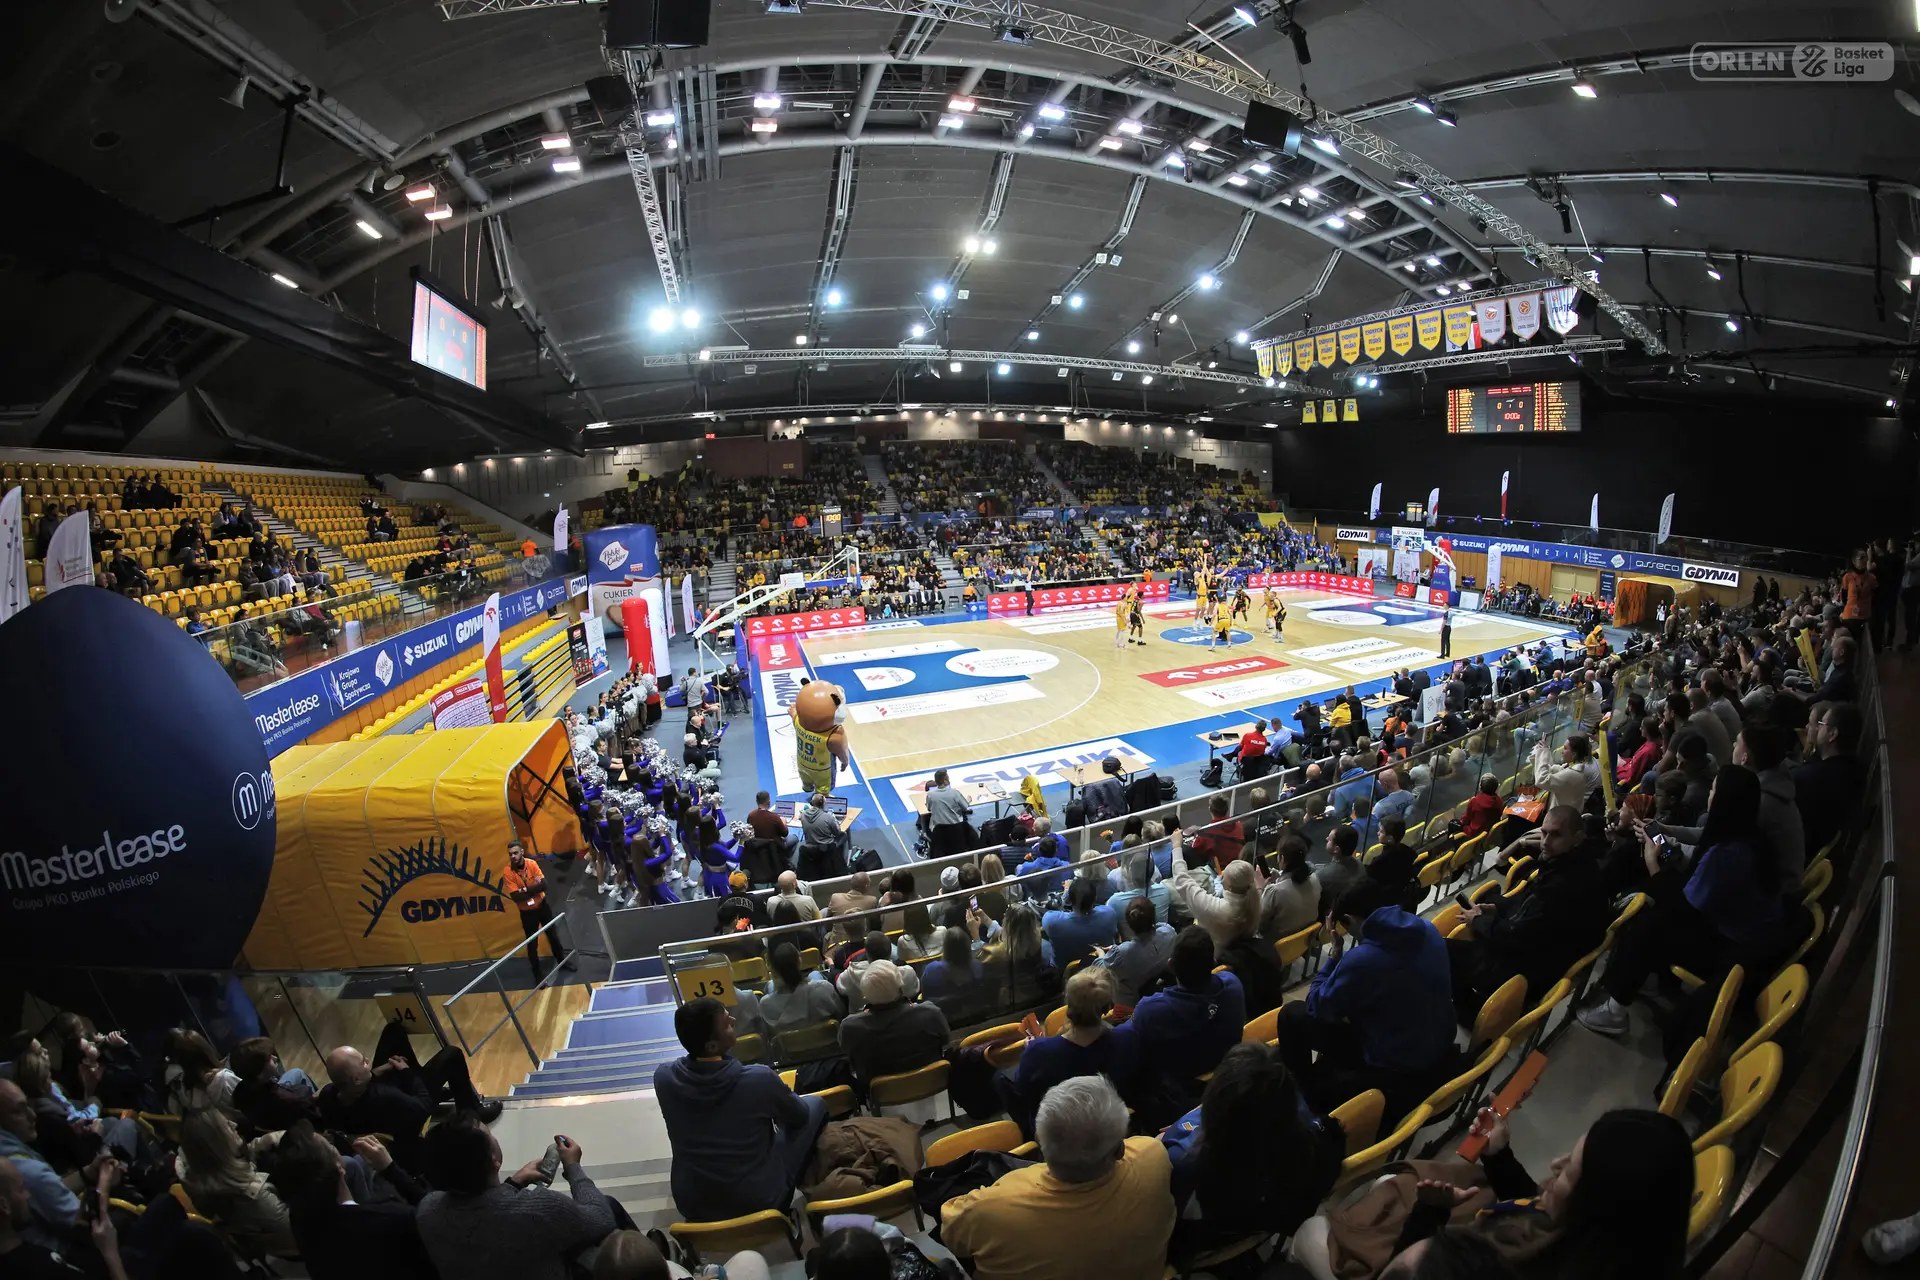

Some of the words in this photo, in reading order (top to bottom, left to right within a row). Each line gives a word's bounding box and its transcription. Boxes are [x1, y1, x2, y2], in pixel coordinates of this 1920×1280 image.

[1338, 530, 1369, 539] GDYNIA
[1459, 540, 1486, 549] SUZUKI
[1635, 560, 1680, 572] asseco
[1684, 566, 1736, 582] GDYNIA
[603, 589, 634, 599] CUKIER
[455, 614, 484, 644] GDYNI
[414, 633, 448, 658] SUZUKI
[338, 667, 360, 681] Krajowa
[1202, 660, 1267, 674] ORLEN
[341, 678, 358, 691] Grupa
[255, 694, 320, 734] Masterlease
[963, 746, 1137, 784] SUZUKI
[0, 824, 188, 890] Masterlease
[13, 896, 44, 911] Grupa
[45, 892, 69, 905] PKO
[71, 886, 106, 903] Banku
[107, 871, 160, 893] Polskiego
[401, 895, 506, 923] GDYNIA
[694, 980, 724, 998] J3
